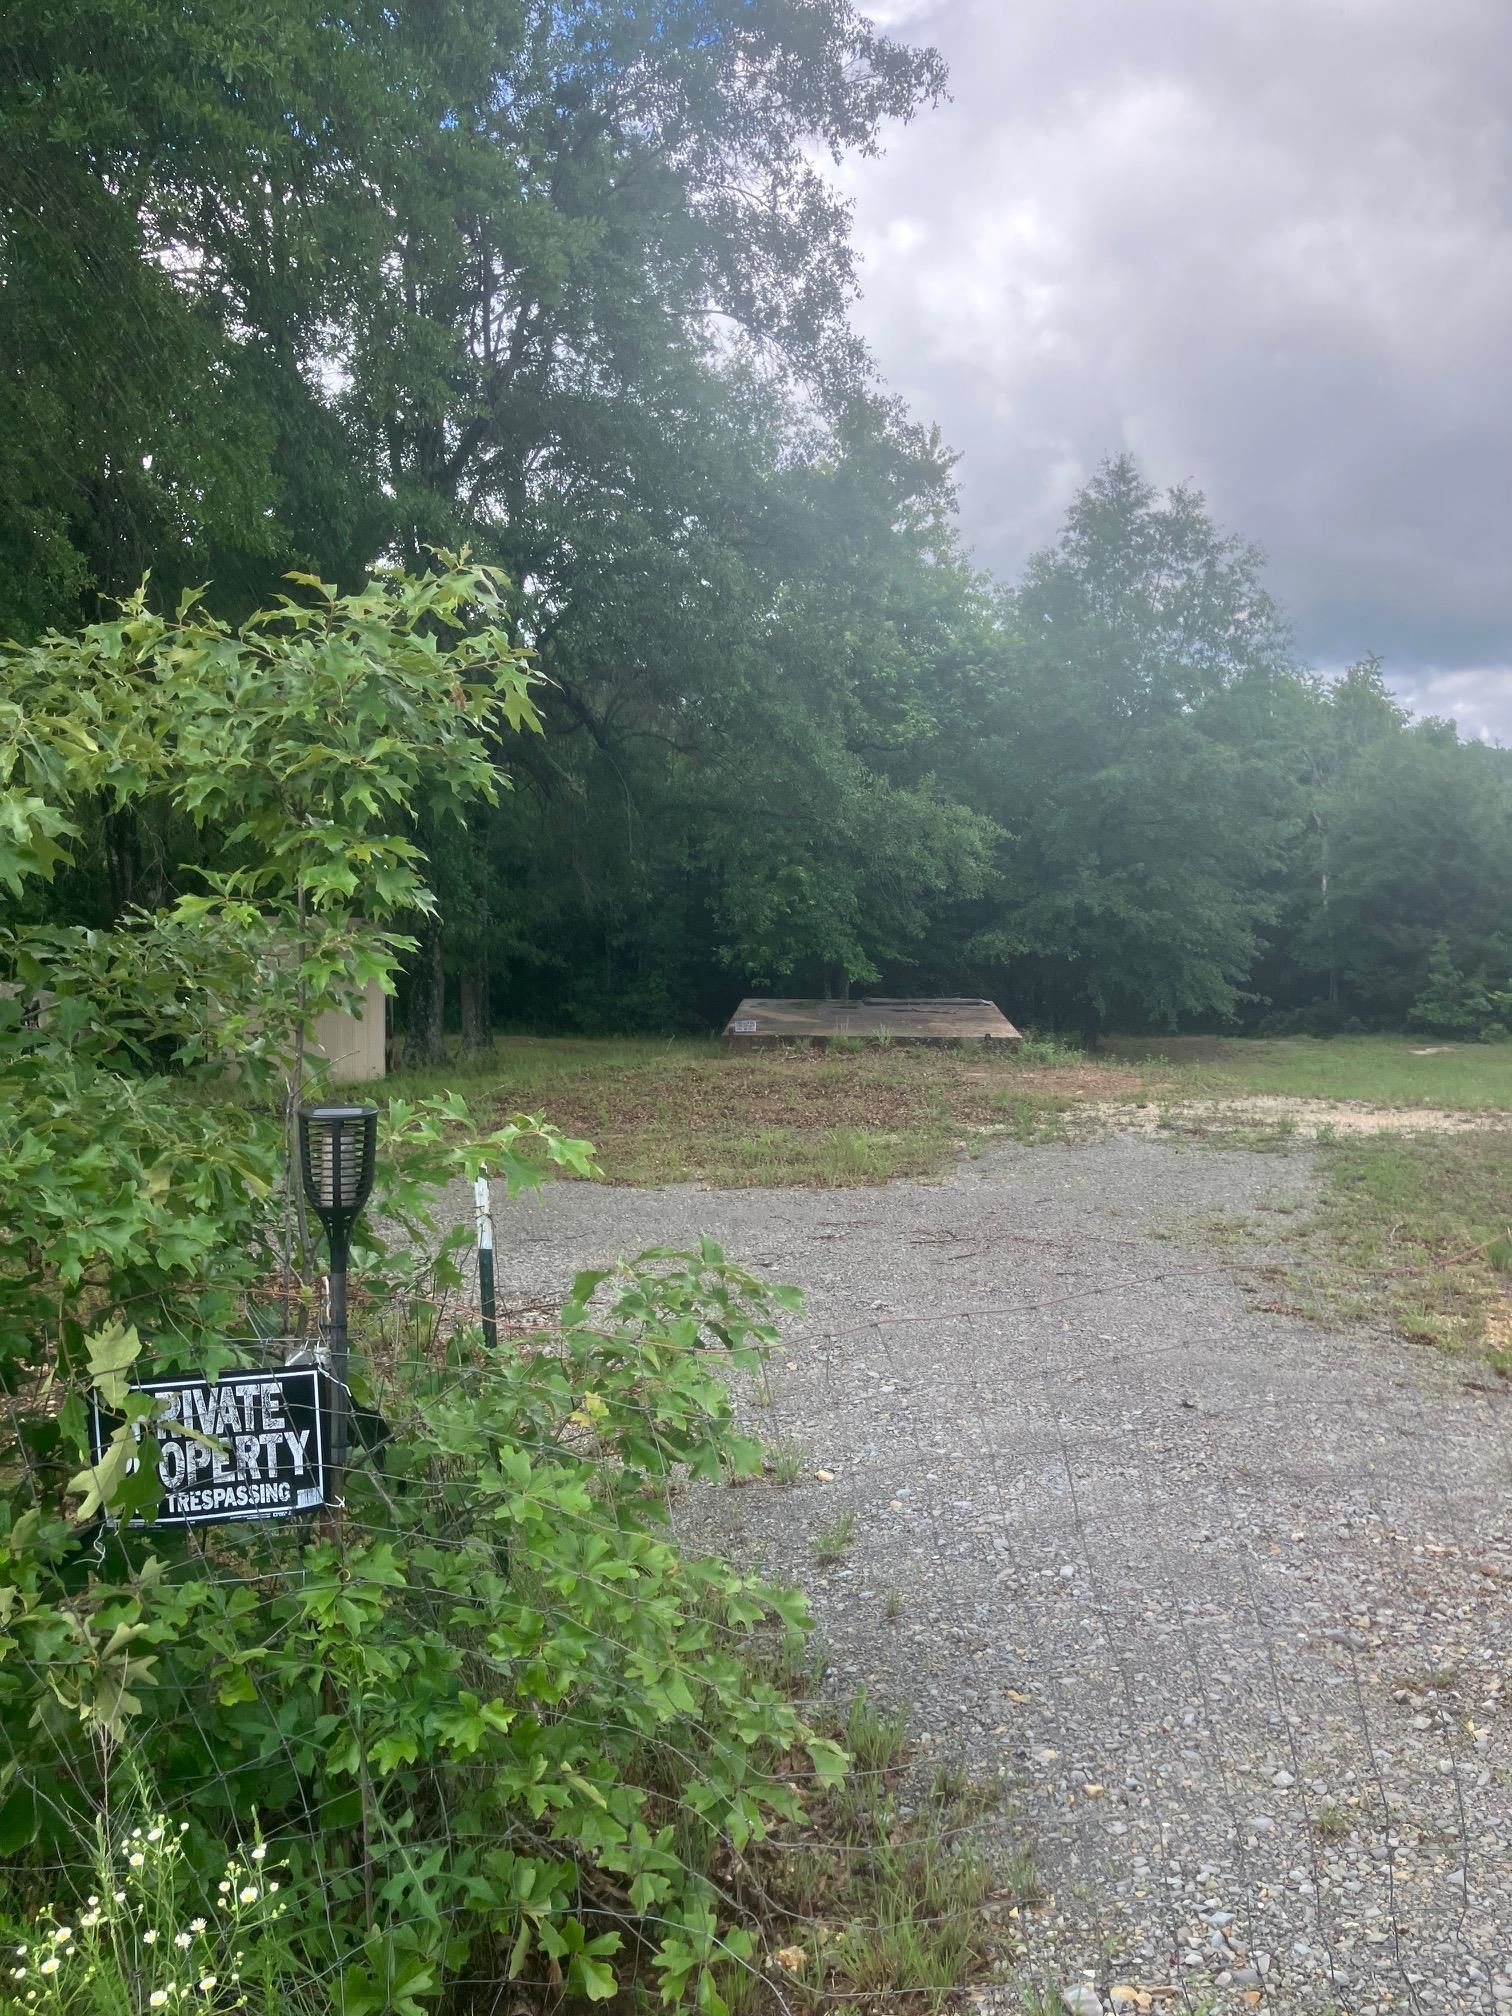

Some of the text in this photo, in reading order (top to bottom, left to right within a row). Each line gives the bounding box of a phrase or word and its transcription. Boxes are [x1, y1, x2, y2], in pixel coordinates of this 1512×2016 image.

[131, 1382, 285, 1441] RIVATE
[125, 1429, 311, 1488] OPERTY
[166, 1481, 291, 1513] TRESPASSING
